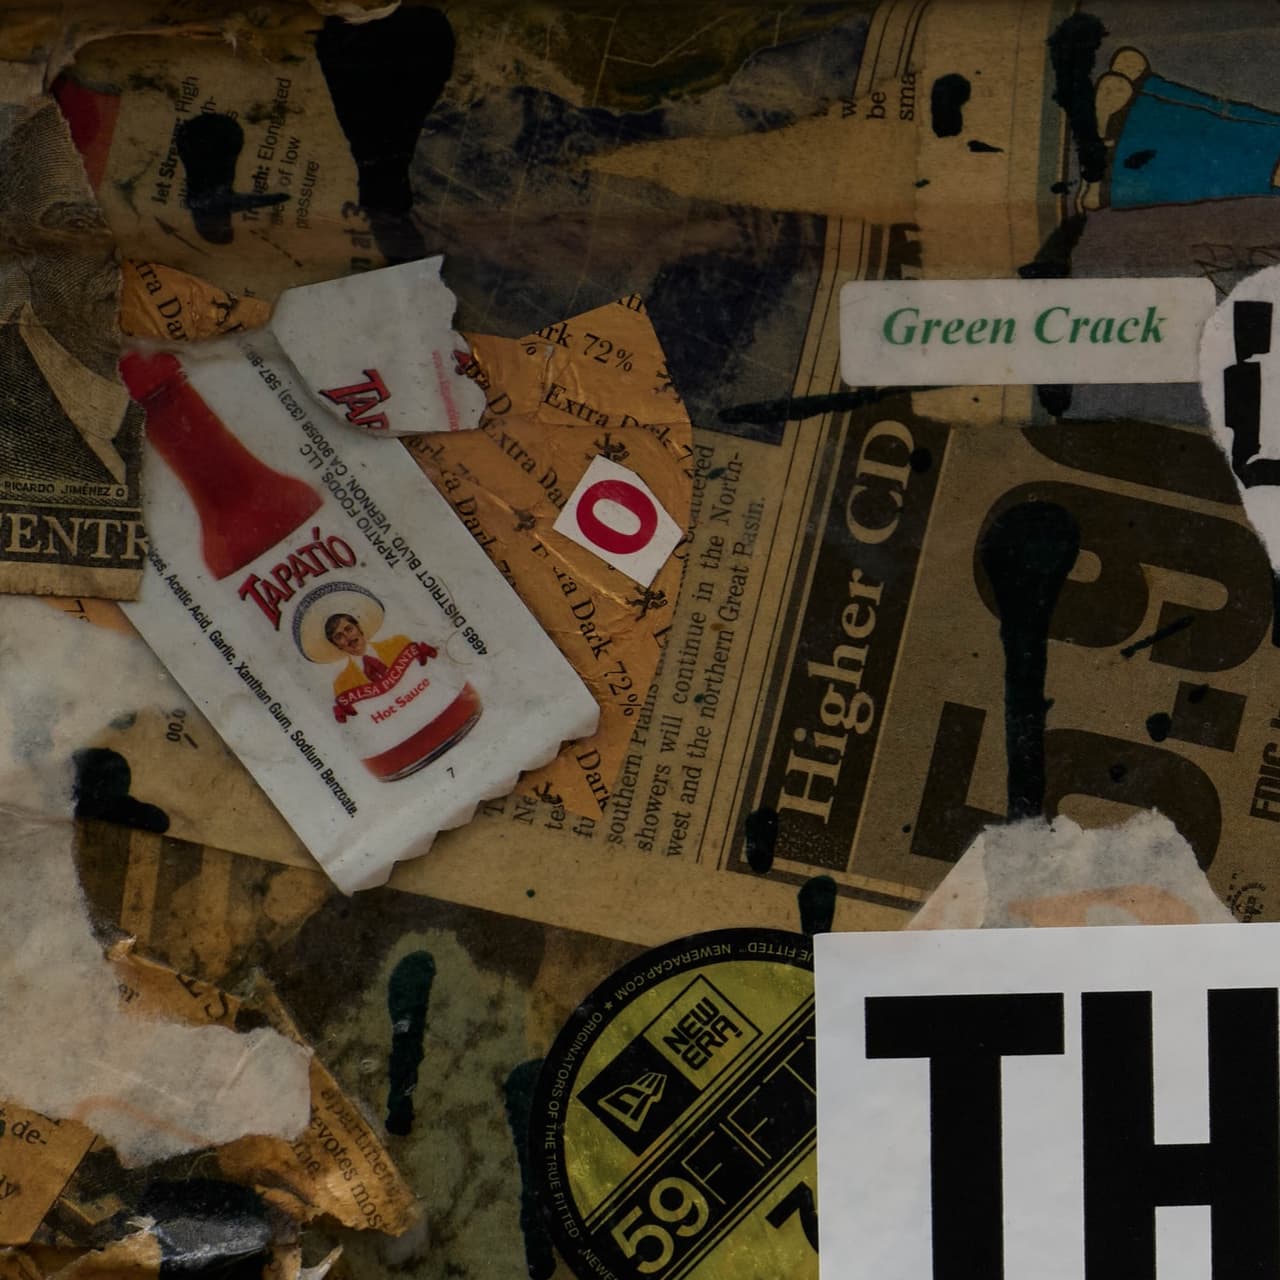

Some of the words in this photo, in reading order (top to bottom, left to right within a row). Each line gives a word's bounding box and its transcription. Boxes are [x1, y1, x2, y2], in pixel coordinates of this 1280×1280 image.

[296, 160, 320, 230] pressure
[582, 331, 633, 373] 72%
[882, 305, 1017, 348] Green
[1033, 303, 1170, 348] Crack
[543, 381, 610, 428] Extra
[356, 511, 398, 570] TAPATIO
[238, 526, 359, 631] TAPATÍO
[698, 630, 736, 722] northern
[718, 568, 751, 625] Great
[775, 567, 885, 824] Higher
[843, 416, 918, 548] CD
[337, 682, 382, 707] SALSA
[382, 642, 421, 689] PICANTE
[669, 611, 707, 705] continue
[233, 661, 272, 707] Xanthan
[290, 730, 326, 773] Sodium
[370, 706, 391, 725] Hot
[393, 677, 431, 710] Sauce
[633, 763, 673, 852] showers
[614, 942, 732, 1002] NEWERACAP.COM
[551, 1013, 604, 1100] ORIGINATORS
[661, 996, 721, 1056] NEW
